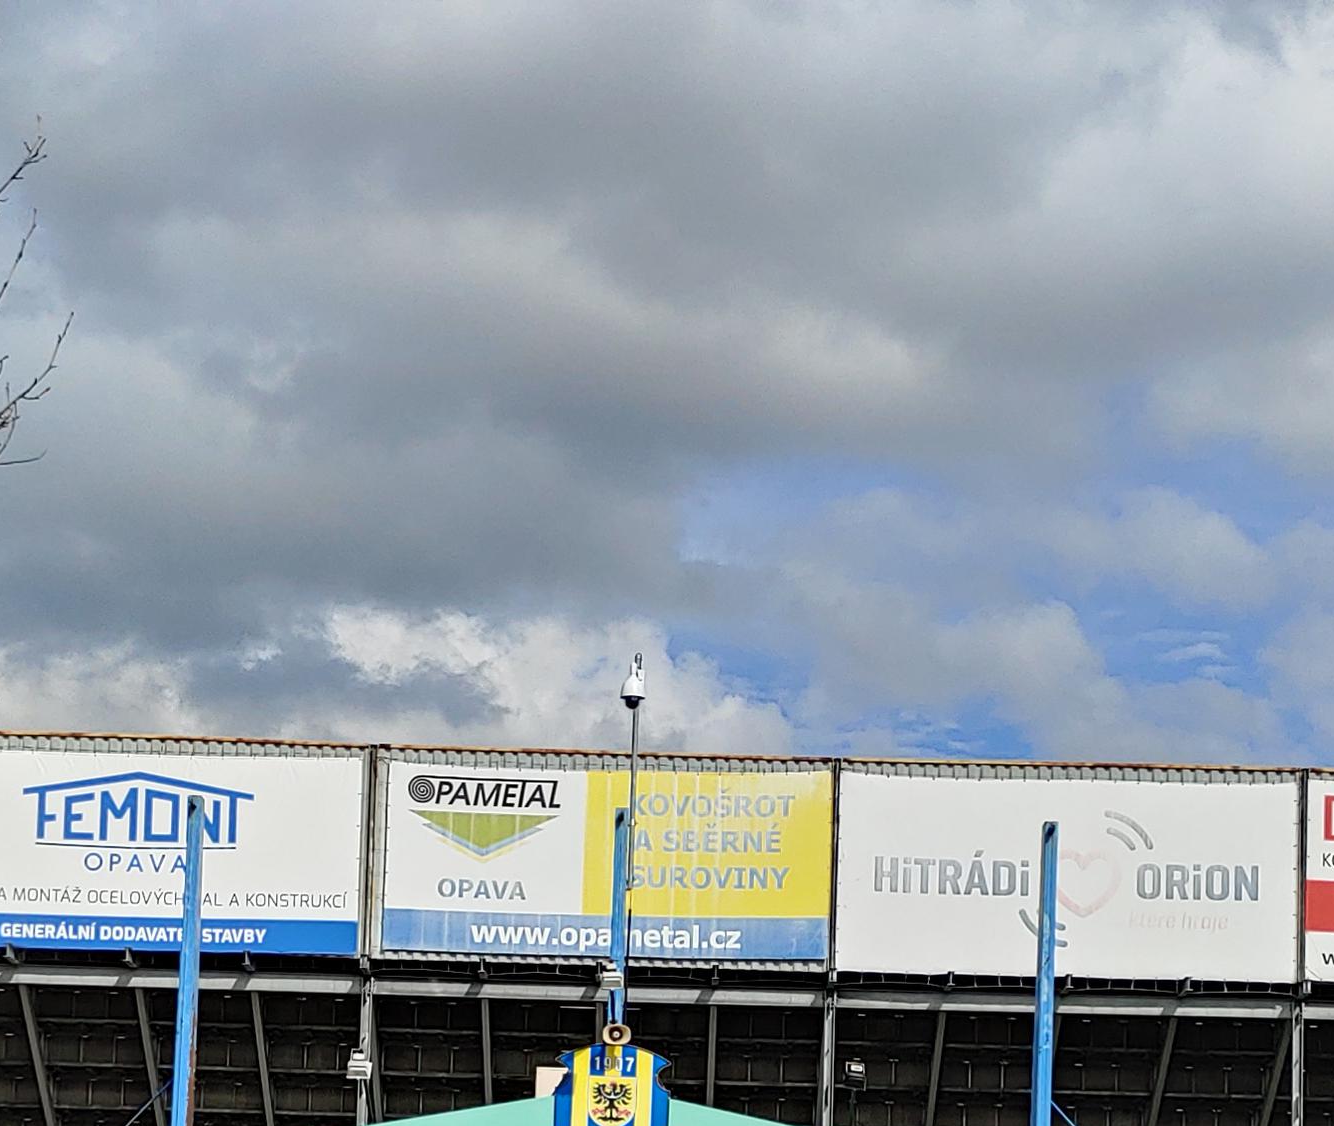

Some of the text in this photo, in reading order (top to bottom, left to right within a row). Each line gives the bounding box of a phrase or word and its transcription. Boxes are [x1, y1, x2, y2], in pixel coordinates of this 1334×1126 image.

[23, 771, 254, 844] FEMONT
[635, 822, 782, 853] A SBĚRNÉ
[83, 851, 186, 873] OPAVA
[436, 877, 526, 901] OPAVA
[632, 865, 791, 890] SUROVINY
[13, 884, 82, 904] MONTÁŽ
[87, 888, 184, 906] OCELOVÝCH
[202, 892, 223, 907] AL
[229, 893, 240, 907] A
[245, 889, 348, 909] KONSTRUKCÍ
[0, 921, 267, 944] GENERÁLNÍ DODAVATE STAVBY
[594, 1056, 635, 1073] 1907
